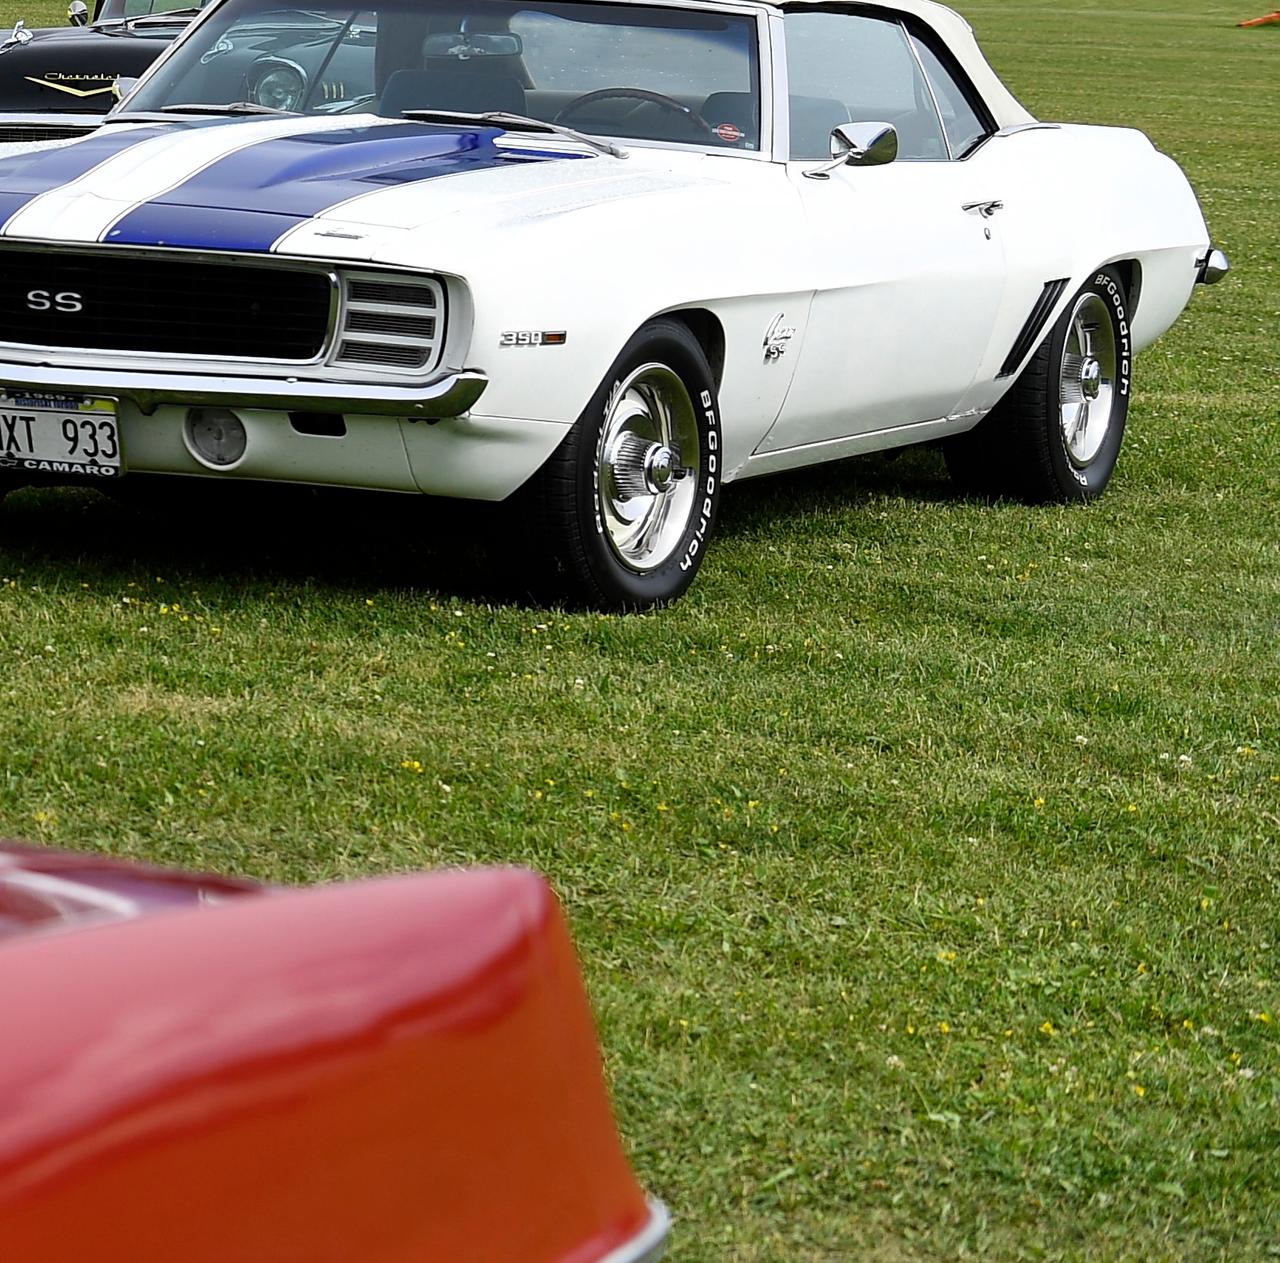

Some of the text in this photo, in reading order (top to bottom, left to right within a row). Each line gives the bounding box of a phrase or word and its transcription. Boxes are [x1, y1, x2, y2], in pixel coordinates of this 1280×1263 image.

[44, 72, 120, 81] Chevrolet
[26, 289, 83, 312] SS
[499, 330, 542, 346] 350
[1094, 274, 1130, 396] BFGoodrich
[61, 418, 118, 459] 933
[23, 459, 117, 477] CAMARO
[679, 389, 718, 572] BFGoodrich
